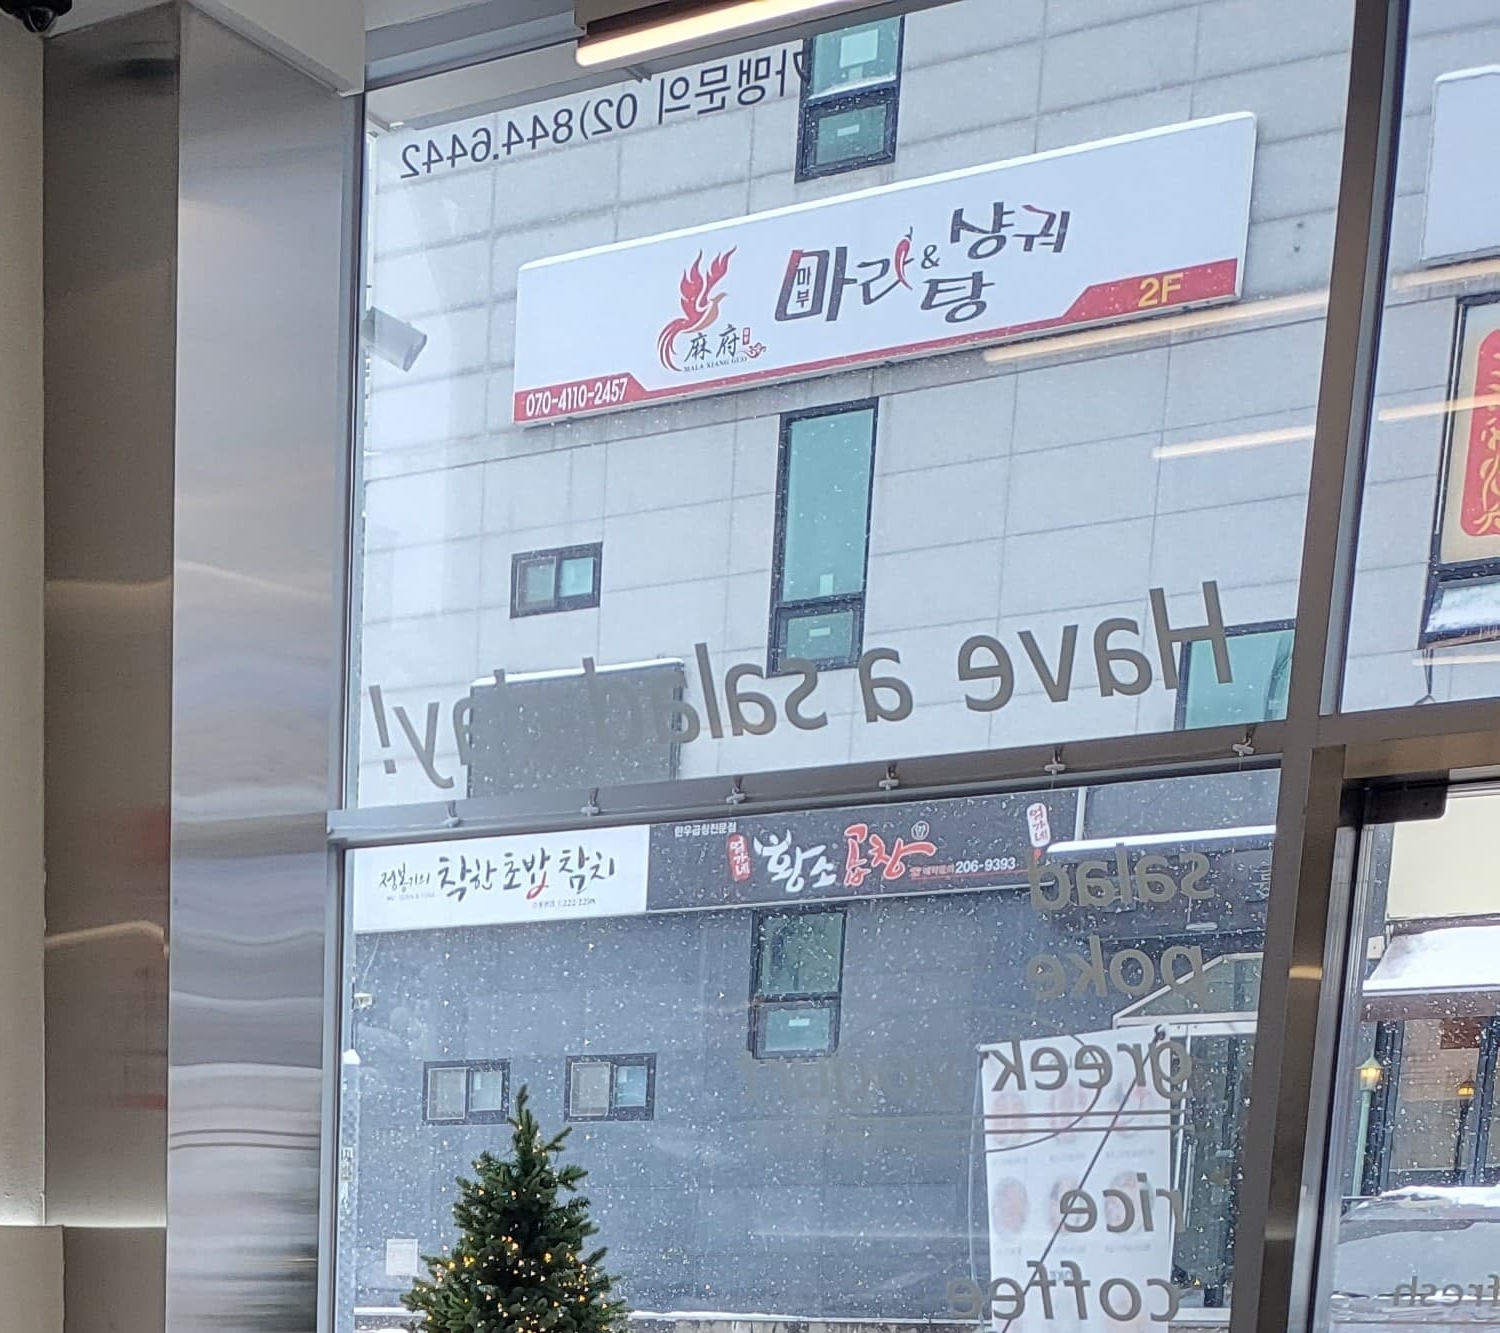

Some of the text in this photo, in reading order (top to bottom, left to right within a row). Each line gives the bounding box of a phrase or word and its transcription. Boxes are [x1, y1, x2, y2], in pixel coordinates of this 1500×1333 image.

[920, 271, 996, 324] 탕
[1137, 271, 1185, 308] 2F
[525, 377, 629, 417] 070-4110-2457
[437, 855, 498, 902] 착한
[502, 847, 551, 900] 초밥
[559, 846, 615, 894] 참치
[844, 823, 938, 888] 곱창
[955, 856, 1016, 875] 206-9393
